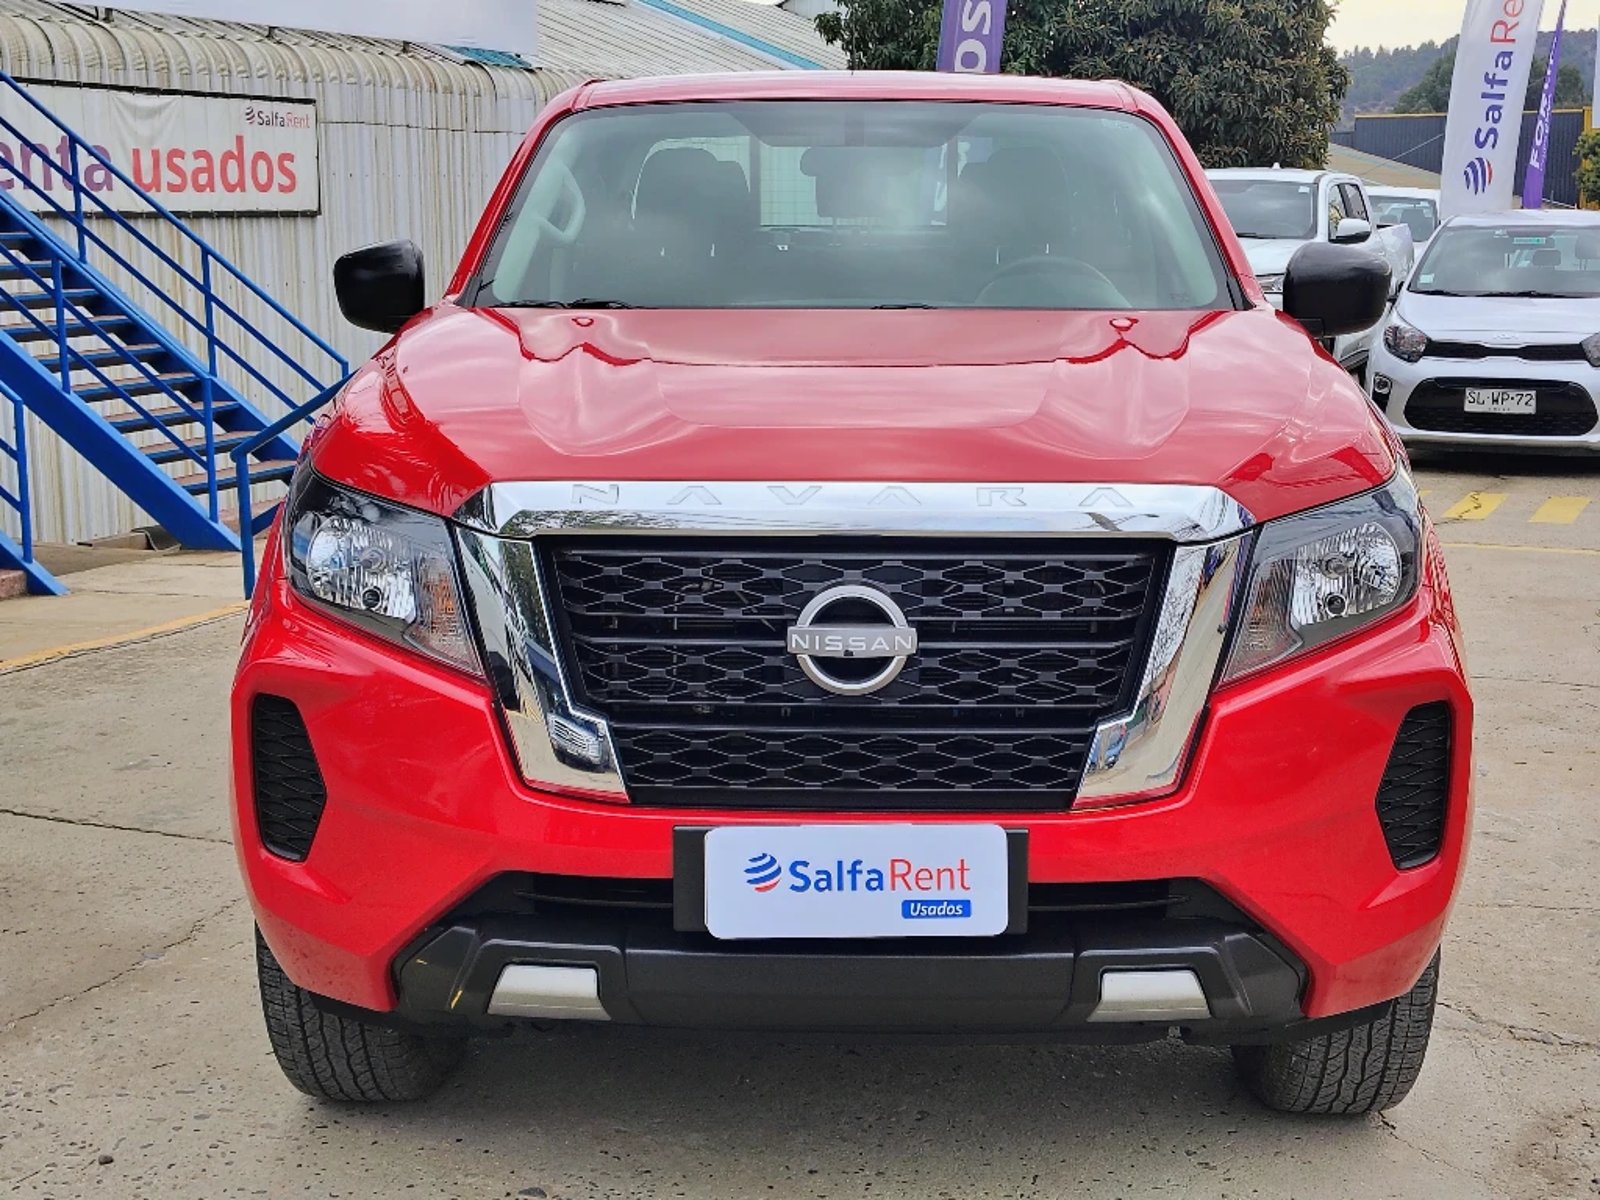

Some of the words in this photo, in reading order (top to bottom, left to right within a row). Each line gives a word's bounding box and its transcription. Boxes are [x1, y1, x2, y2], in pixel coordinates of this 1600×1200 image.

[257, 110, 311, 129] SalfaRent
[131, 135, 297, 193] usados
[571, 484, 1134, 507] NAVARA
[791, 633, 913, 651] NISSAN
[788, 858, 972, 893] SalfaRent
[910, 902, 964, 917] Usados
